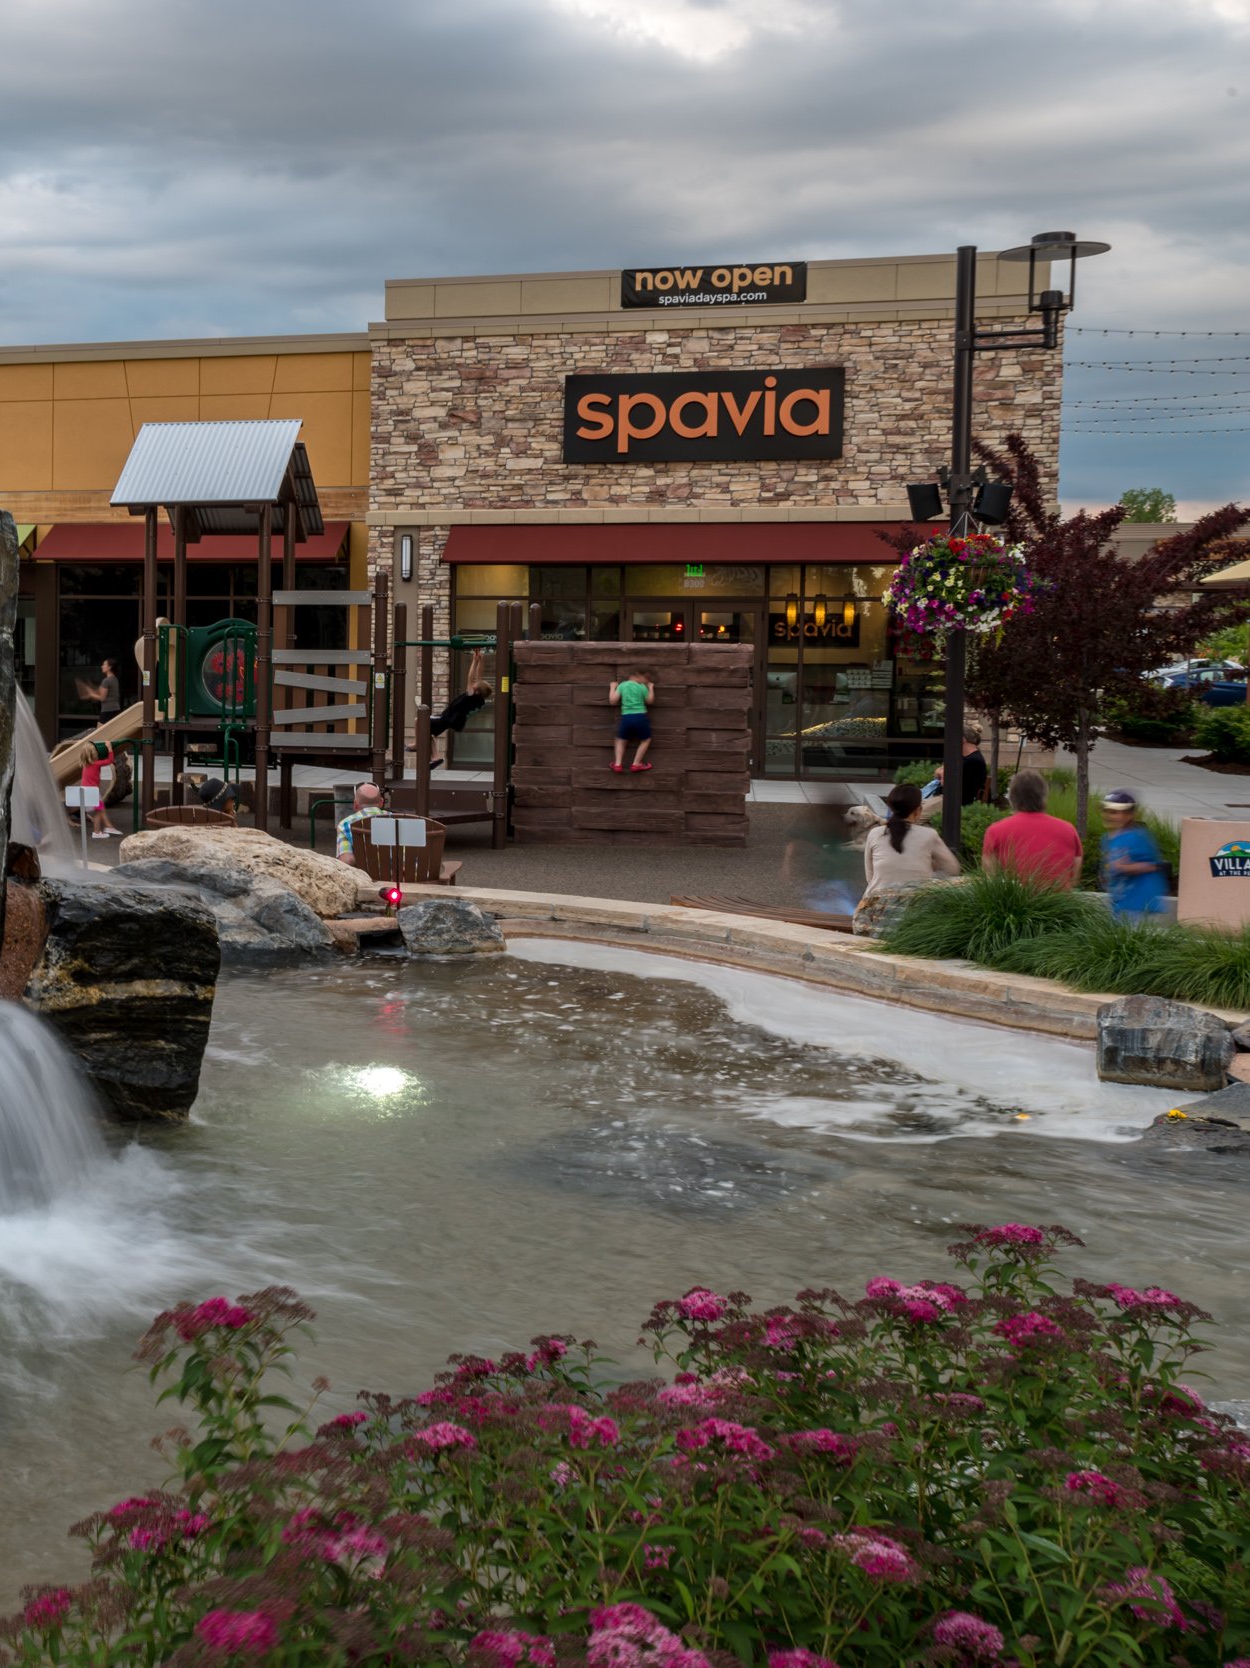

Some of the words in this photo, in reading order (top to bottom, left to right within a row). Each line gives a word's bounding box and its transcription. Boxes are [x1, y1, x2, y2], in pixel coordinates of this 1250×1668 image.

[635, 268, 704, 292] now
[711, 264, 793, 293] open
[658, 291, 767, 306] spaviadayspa.com
[576, 376, 831, 453] spavia
[774, 619, 852, 640] spavia
